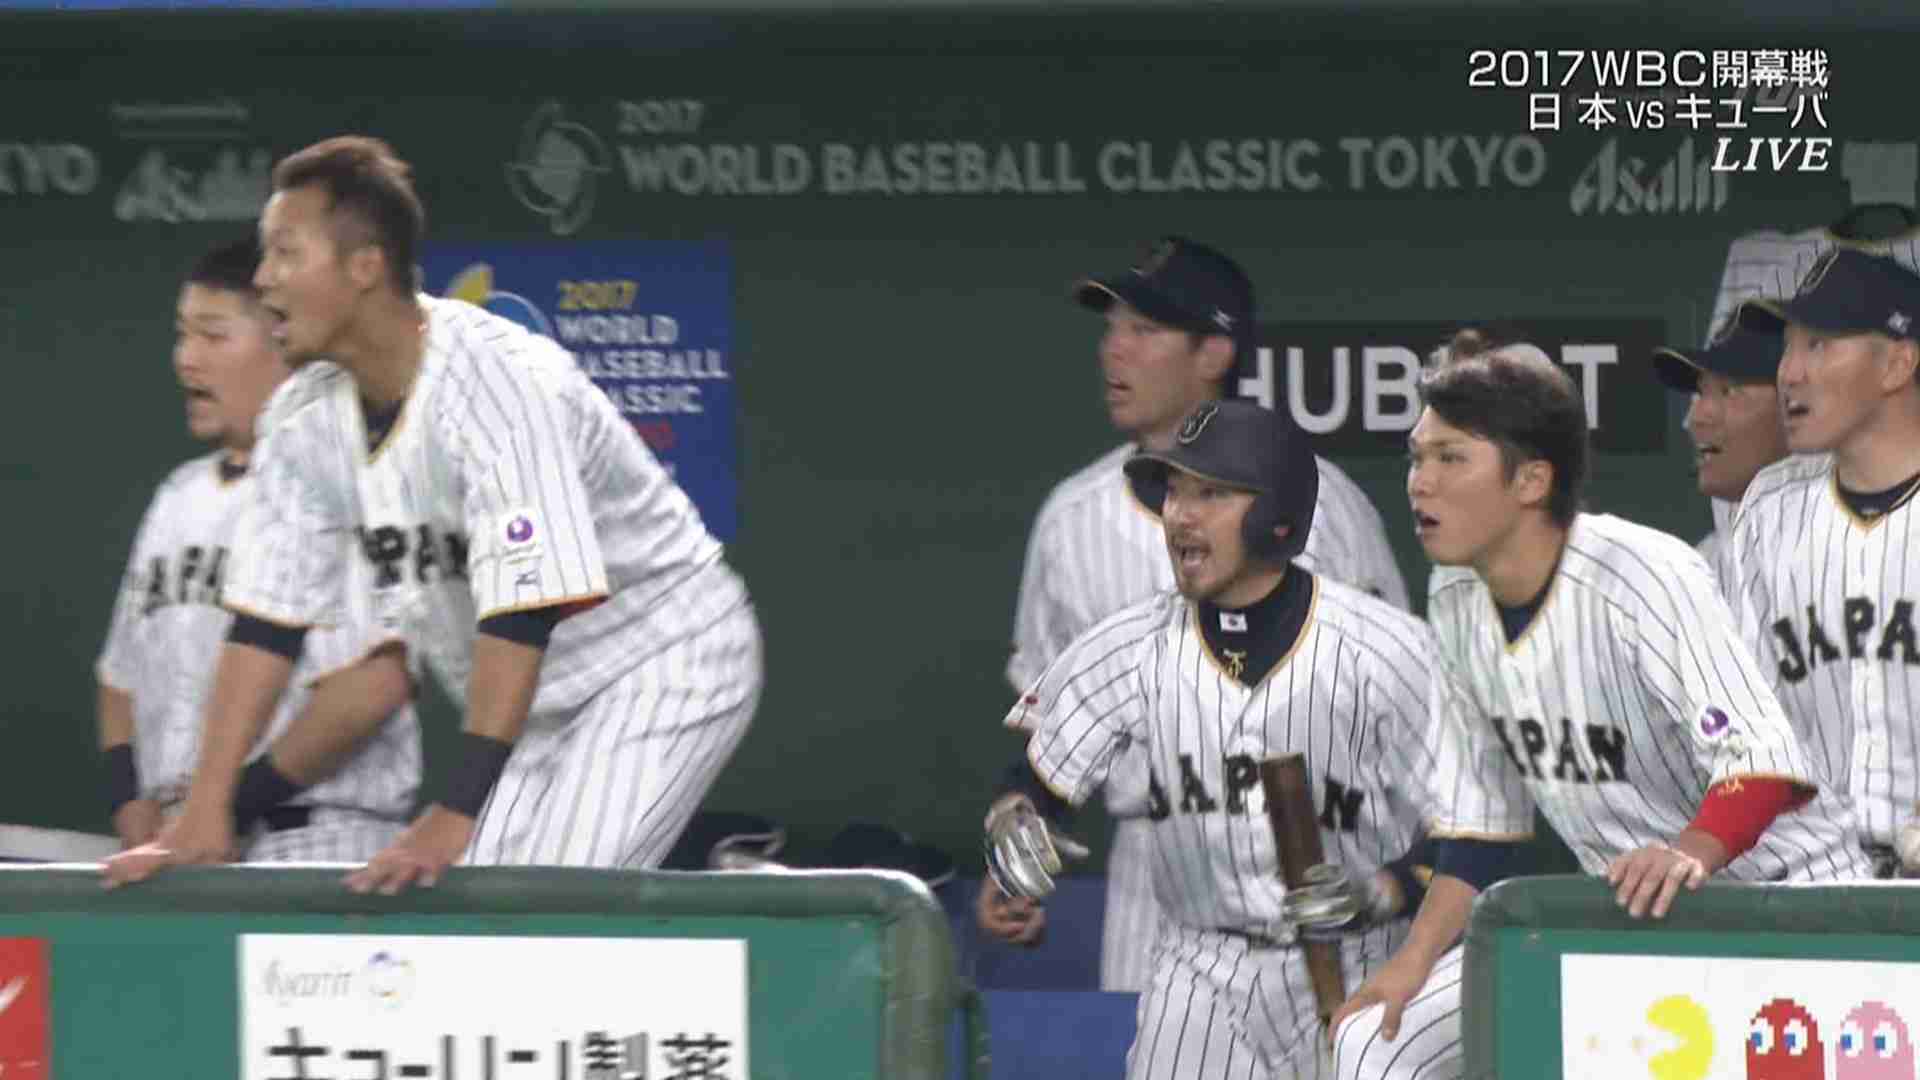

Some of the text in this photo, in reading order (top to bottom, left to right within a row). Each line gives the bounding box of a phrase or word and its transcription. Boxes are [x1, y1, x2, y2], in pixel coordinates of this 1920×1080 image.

[617, 100, 704, 133] 2017
[617, 134, 1547, 196] WORLD BASEBALL CLASSIC TOKYO
[555, 314, 679, 344] WORLD
[1772, 596, 1920, 684] JAPA
[1491, 716, 1628, 784] APAN
[1147, 753, 1365, 831] JAPN
